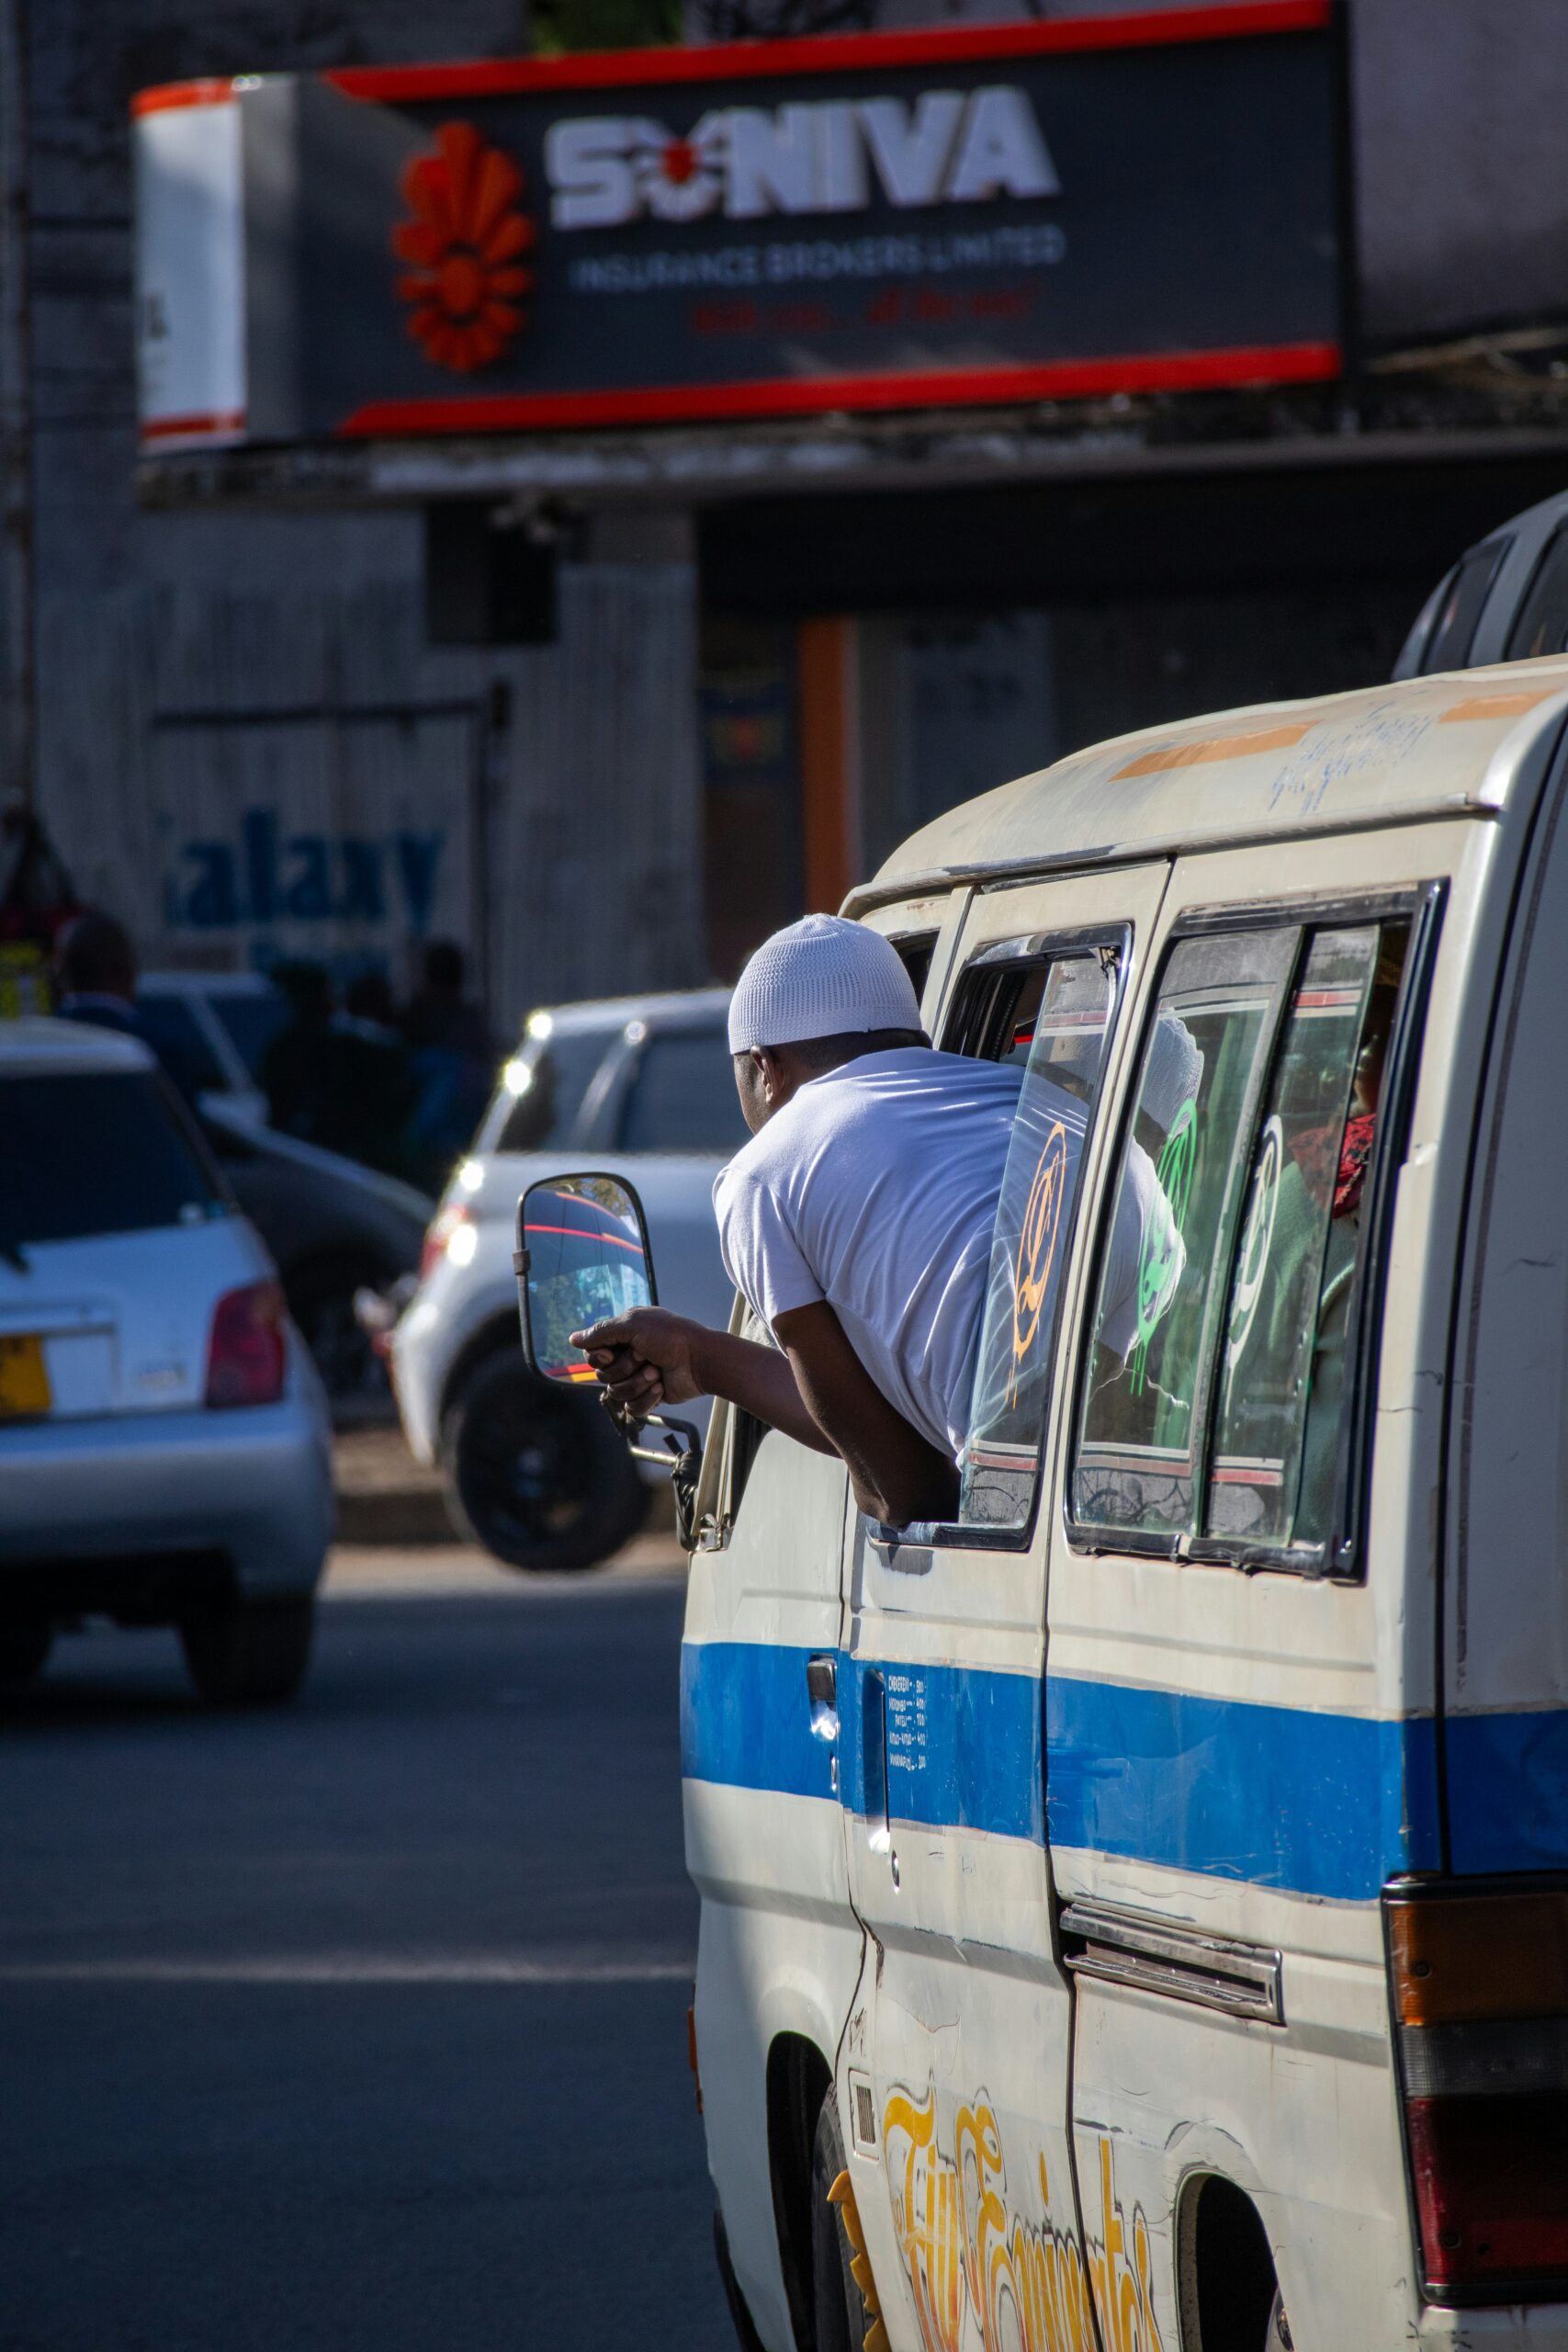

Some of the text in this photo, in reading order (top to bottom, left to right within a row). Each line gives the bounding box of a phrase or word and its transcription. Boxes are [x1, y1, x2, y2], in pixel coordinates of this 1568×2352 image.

[545, 85, 1061, 231] SONIVA
[569, 223, 1066, 293] INSURANCE BROKERS LIMITED
